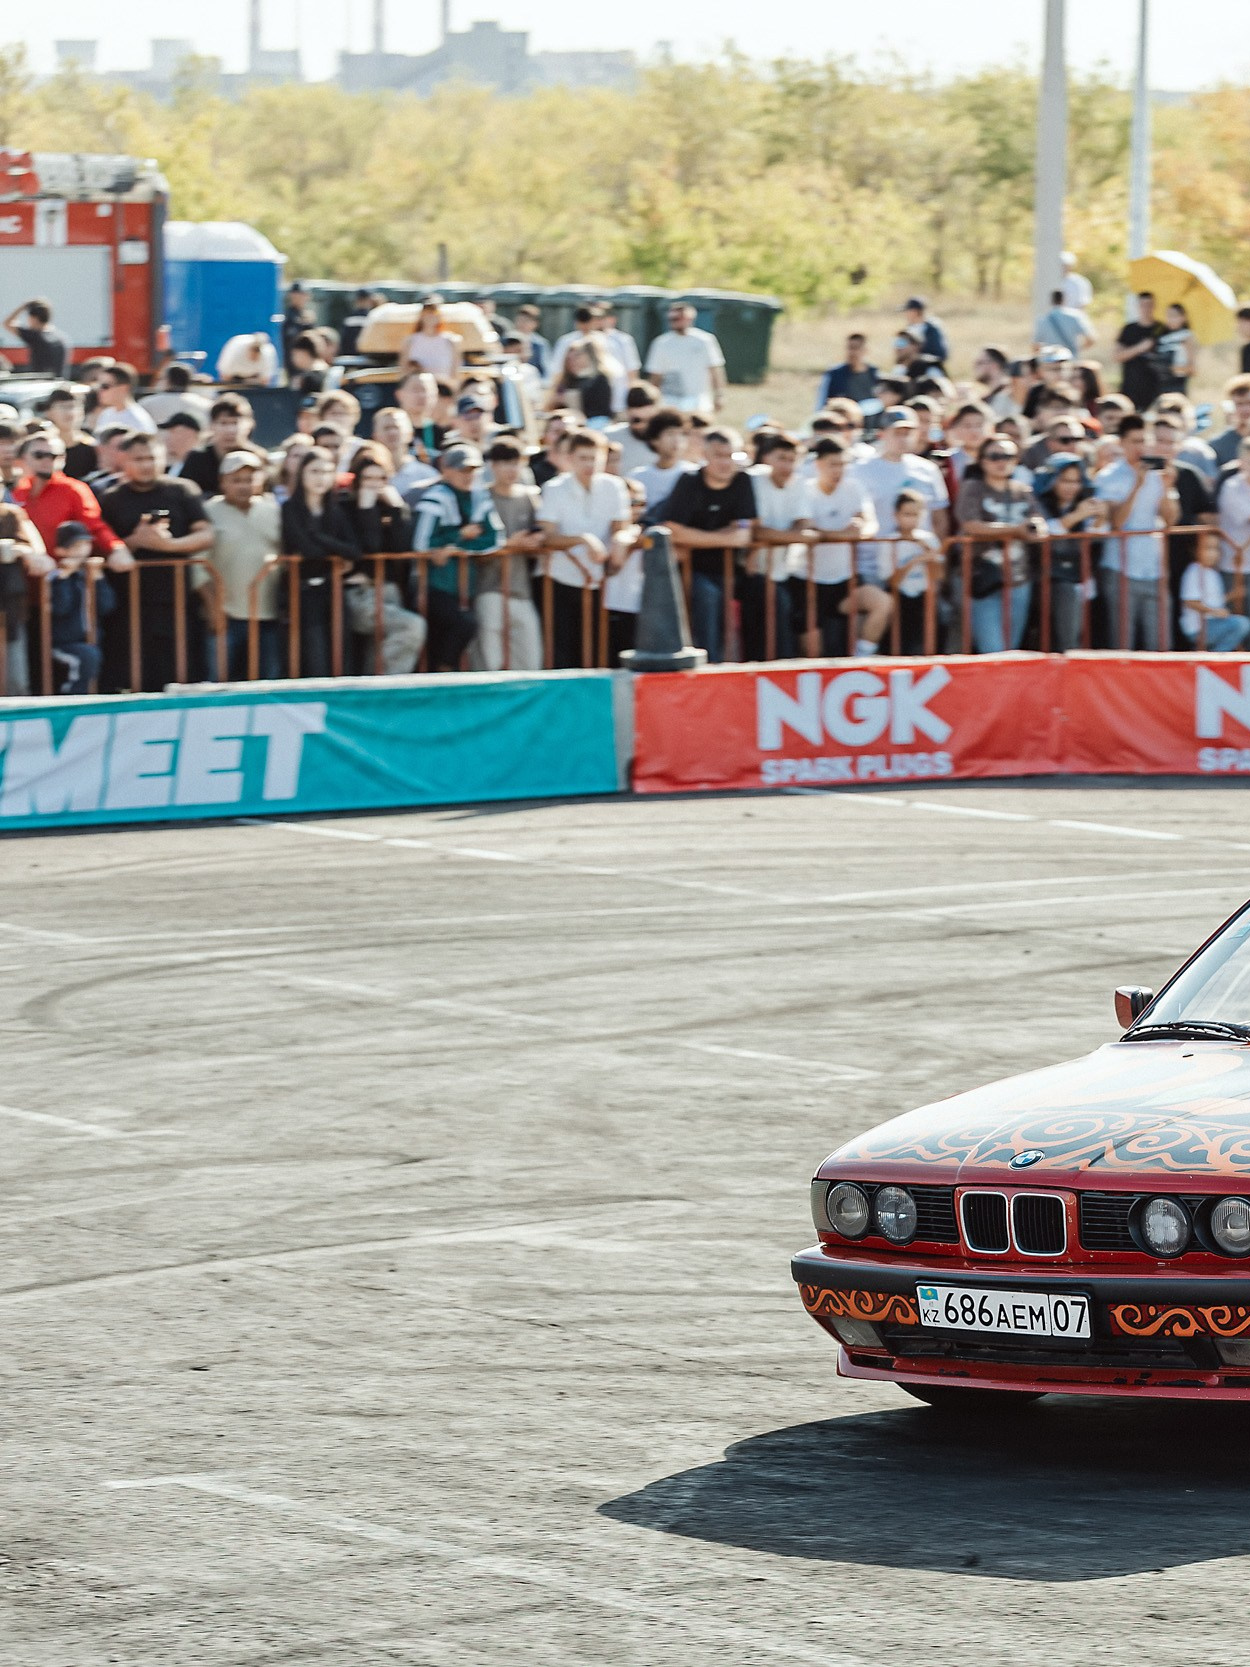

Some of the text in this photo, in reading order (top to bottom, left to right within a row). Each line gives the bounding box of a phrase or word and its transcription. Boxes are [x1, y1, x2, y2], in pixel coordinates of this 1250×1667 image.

[757, 665, 953, 751] NGK
[0, 702, 327, 817] MEET
[761, 751, 954, 784] SPARK PLUGS
[922, 1308, 940, 1322] KZ
[1053, 1300, 1086, 1333] 07
